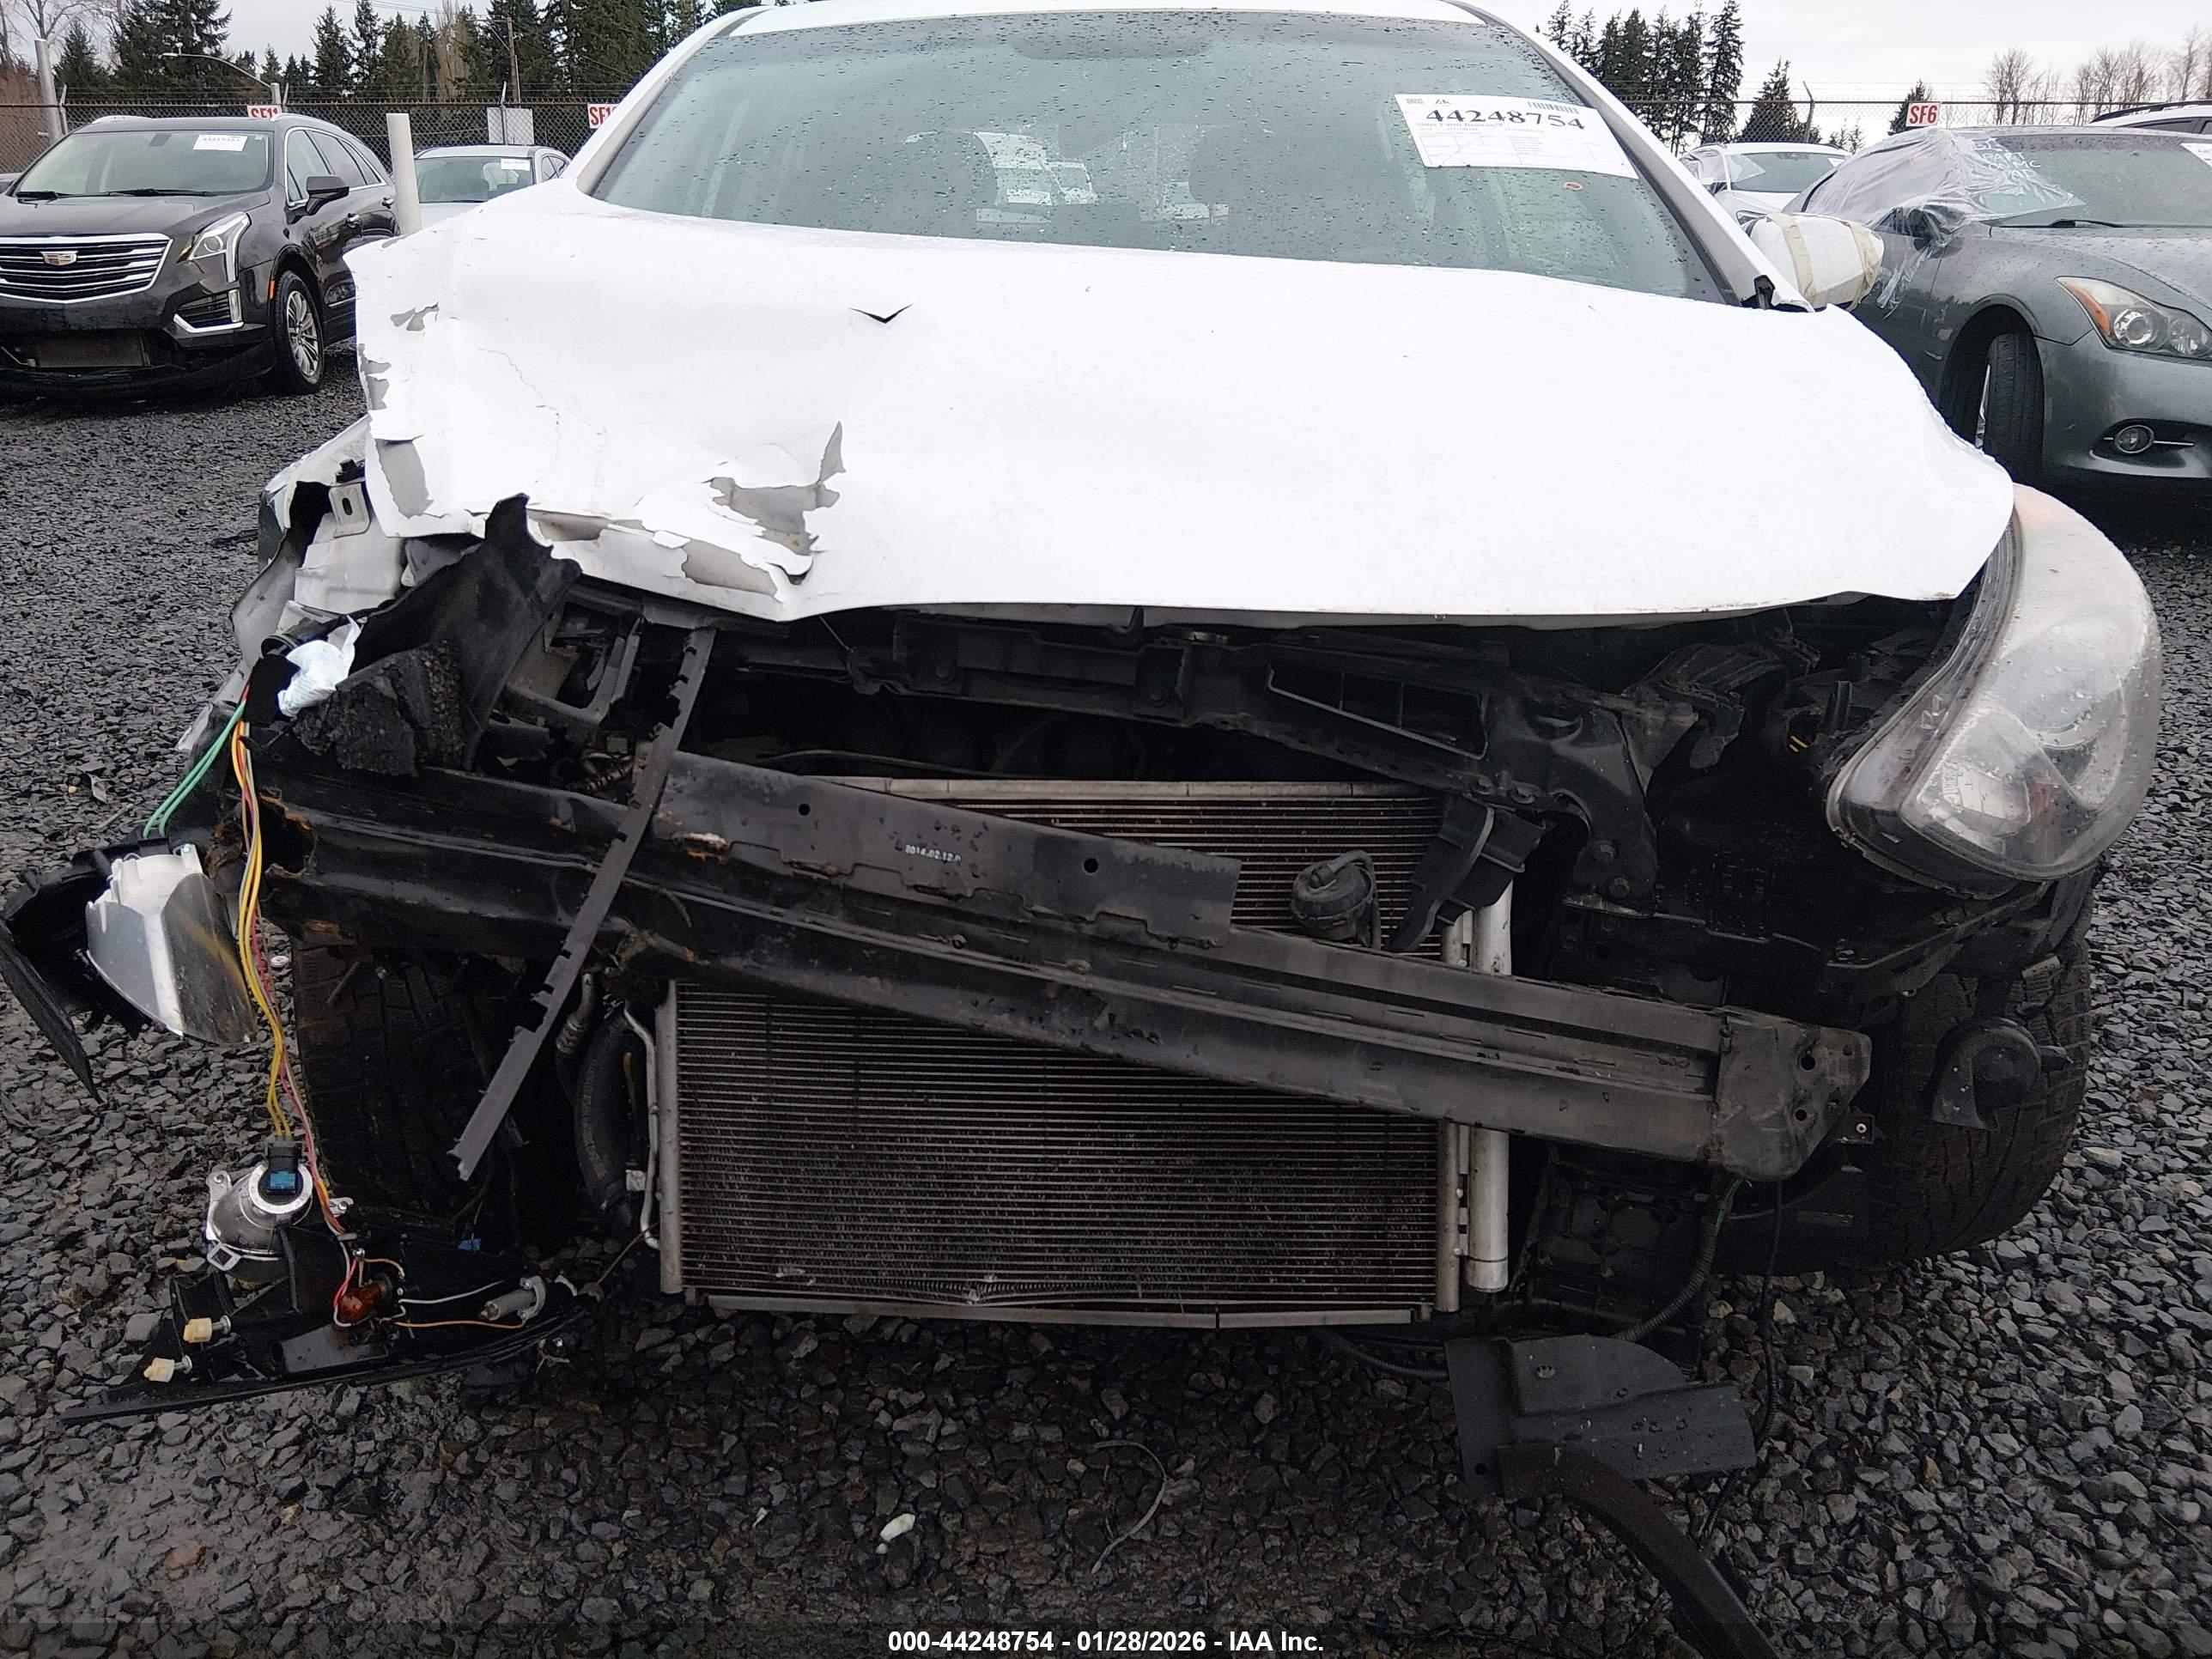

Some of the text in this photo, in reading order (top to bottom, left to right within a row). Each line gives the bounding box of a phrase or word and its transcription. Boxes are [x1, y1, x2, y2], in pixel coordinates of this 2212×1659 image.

[589, 106, 617, 126] SF1
[1426, 109, 1585, 130] 44248754
[1909, 105, 1938, 125] SF6
